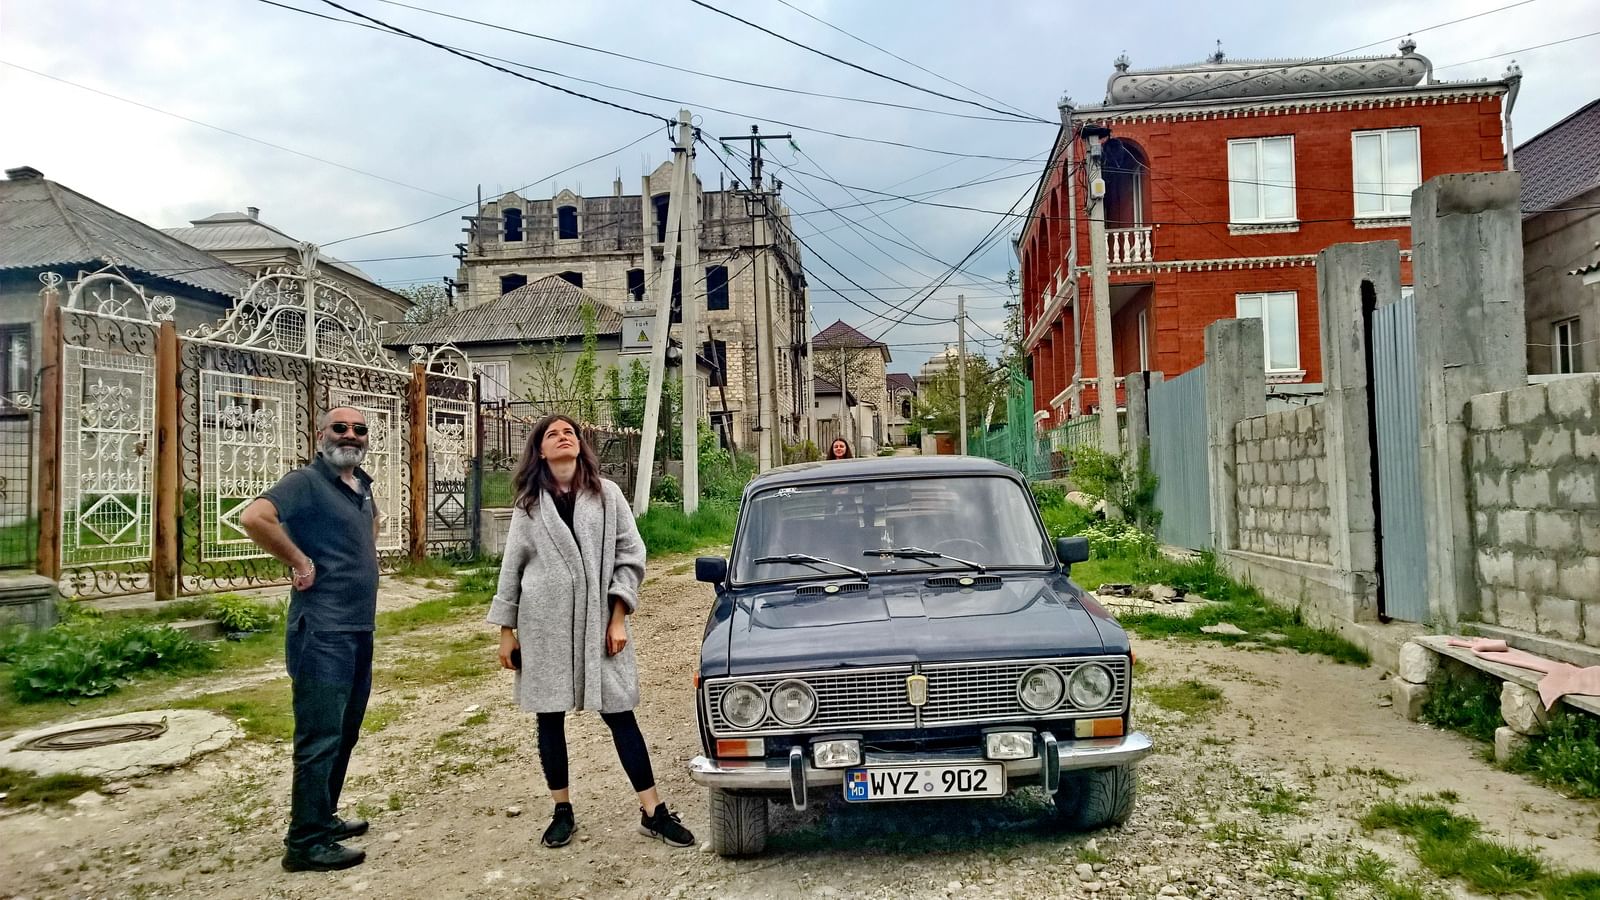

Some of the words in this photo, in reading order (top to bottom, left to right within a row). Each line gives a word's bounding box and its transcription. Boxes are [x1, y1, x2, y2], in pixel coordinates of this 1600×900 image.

[851, 786, 865, 797] MD
[870, 771, 919, 796] WYZ
[941, 769, 988, 793] 902
